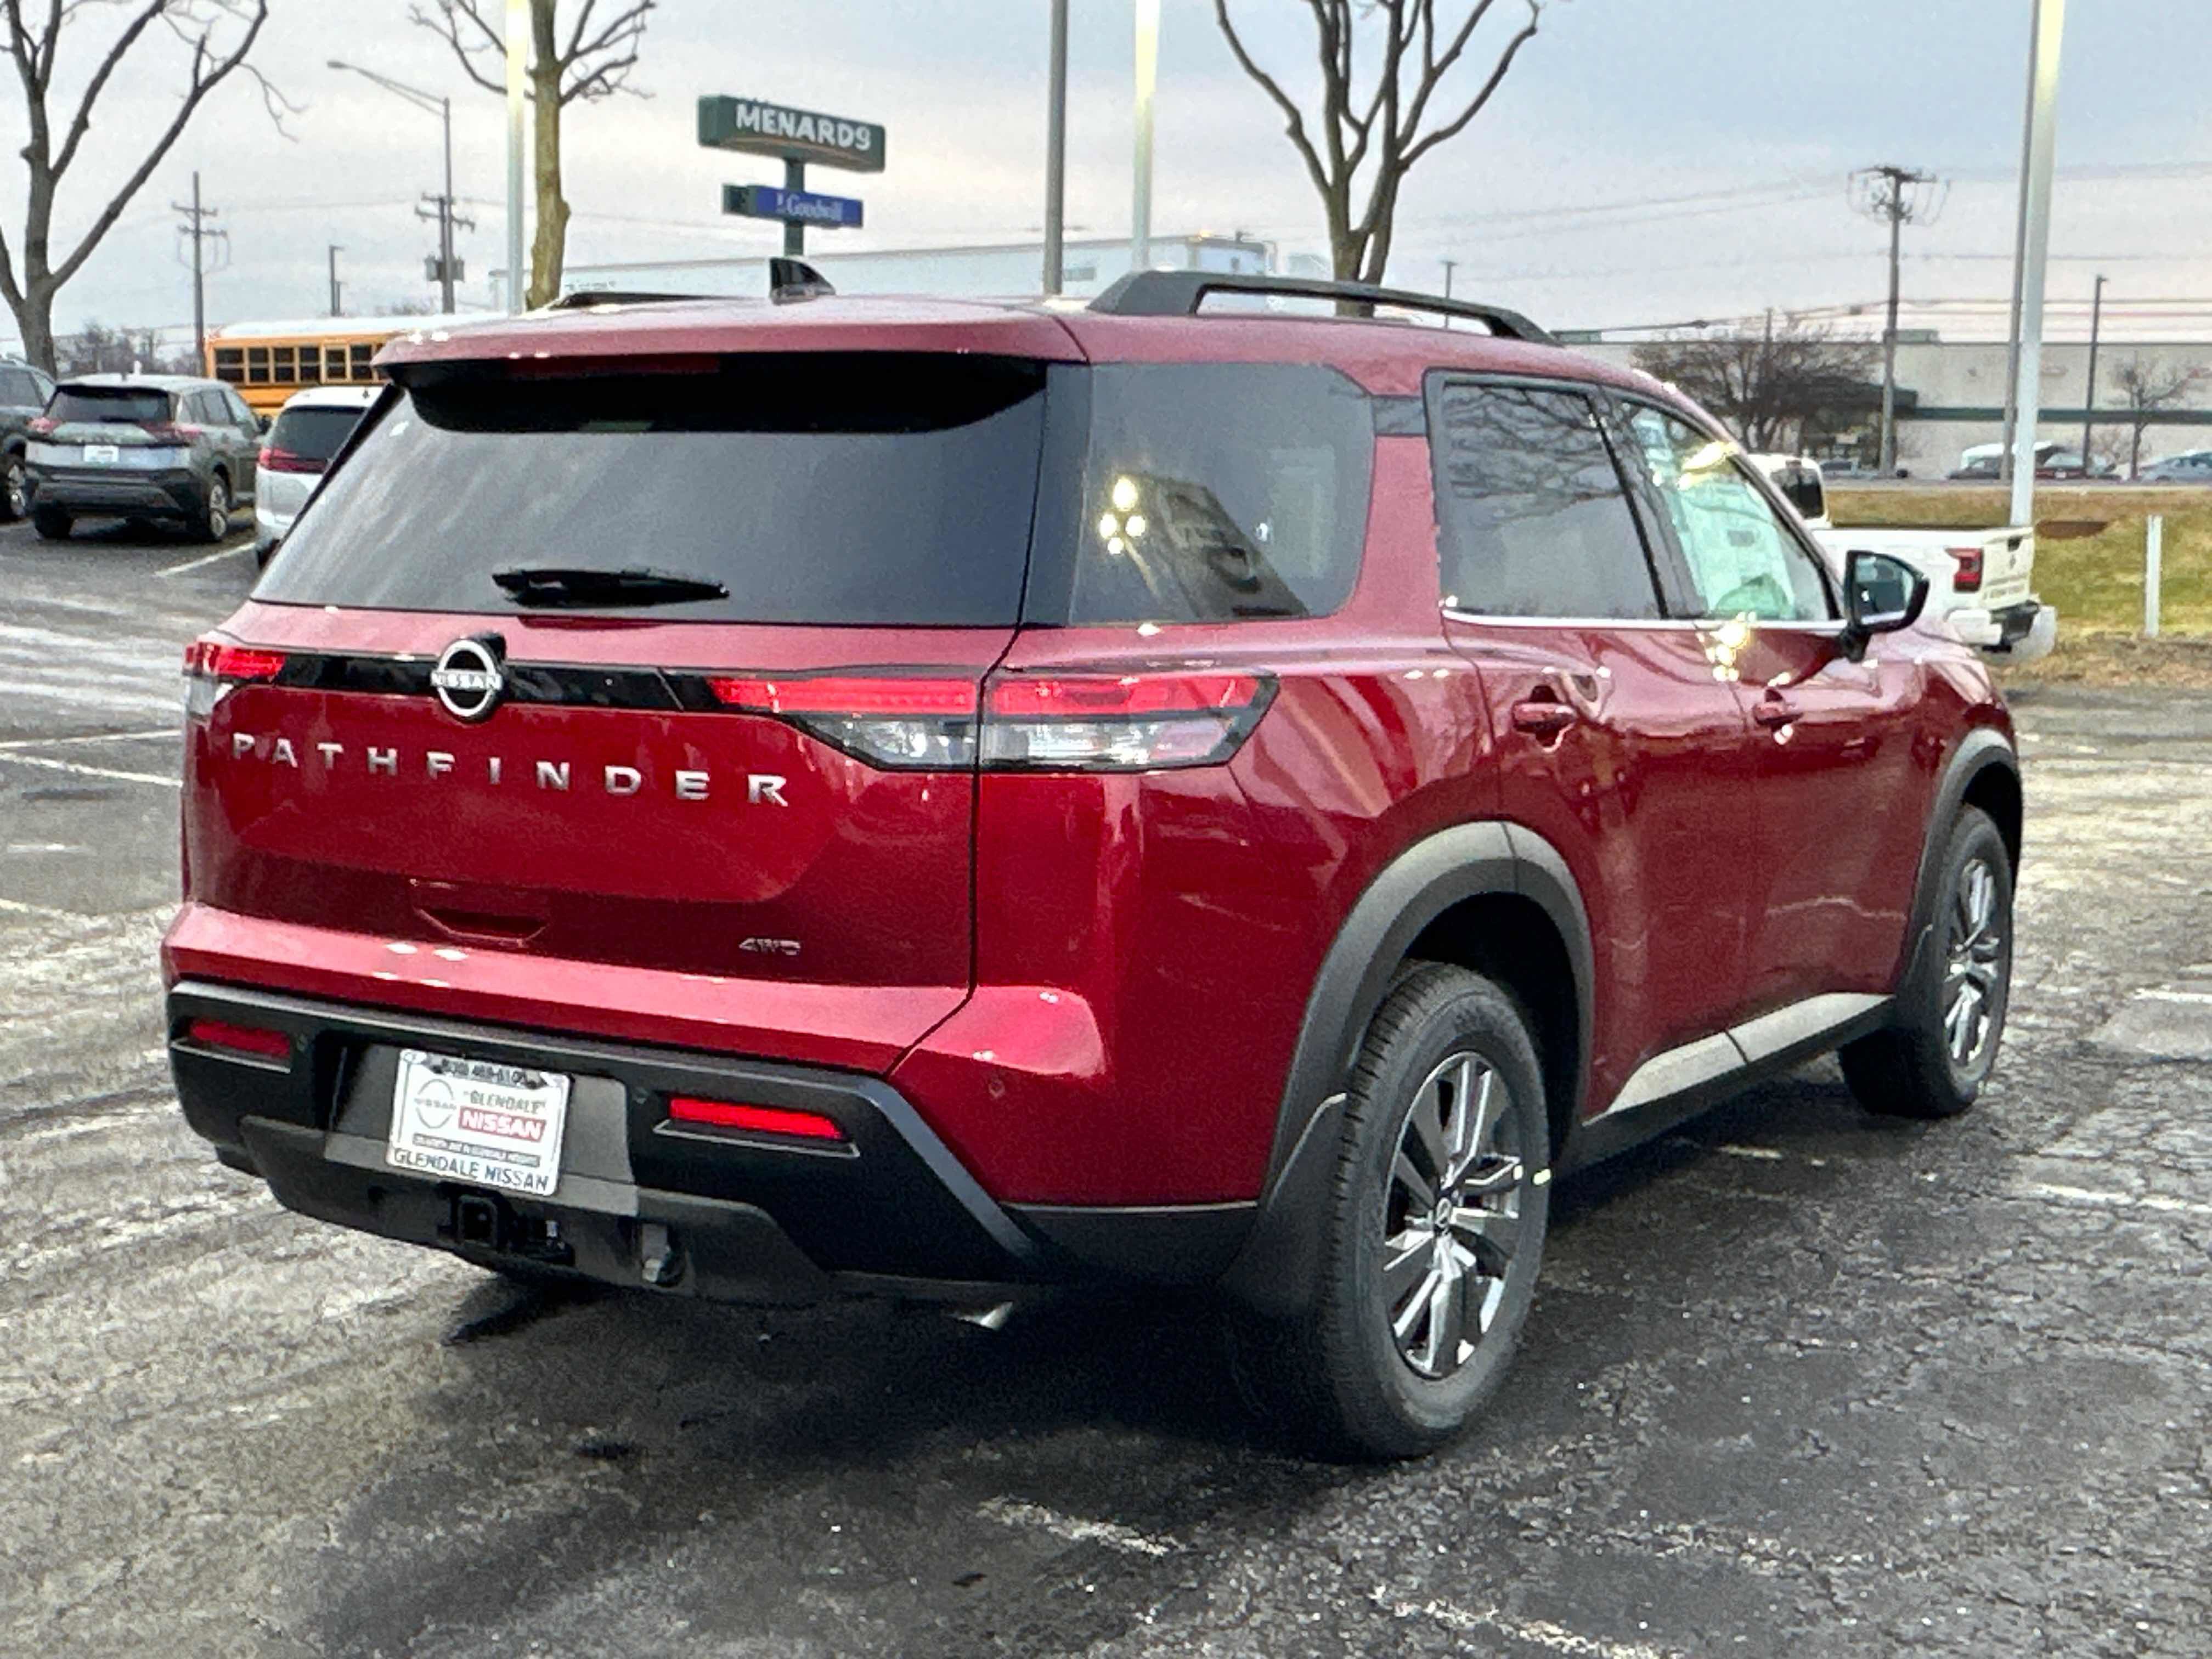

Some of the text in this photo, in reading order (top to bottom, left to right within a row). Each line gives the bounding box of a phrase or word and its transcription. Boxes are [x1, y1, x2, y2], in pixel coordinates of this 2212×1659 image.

[431, 670, 503, 691] NISSAN
[232, 732, 788, 807] PATHFINDER
[738, 937, 801, 956] 4WD
[461, 1108, 542, 1139] NISSAN
[393, 1148, 479, 1178] GLENDALE
[485, 1164, 549, 1191] NISSAN
